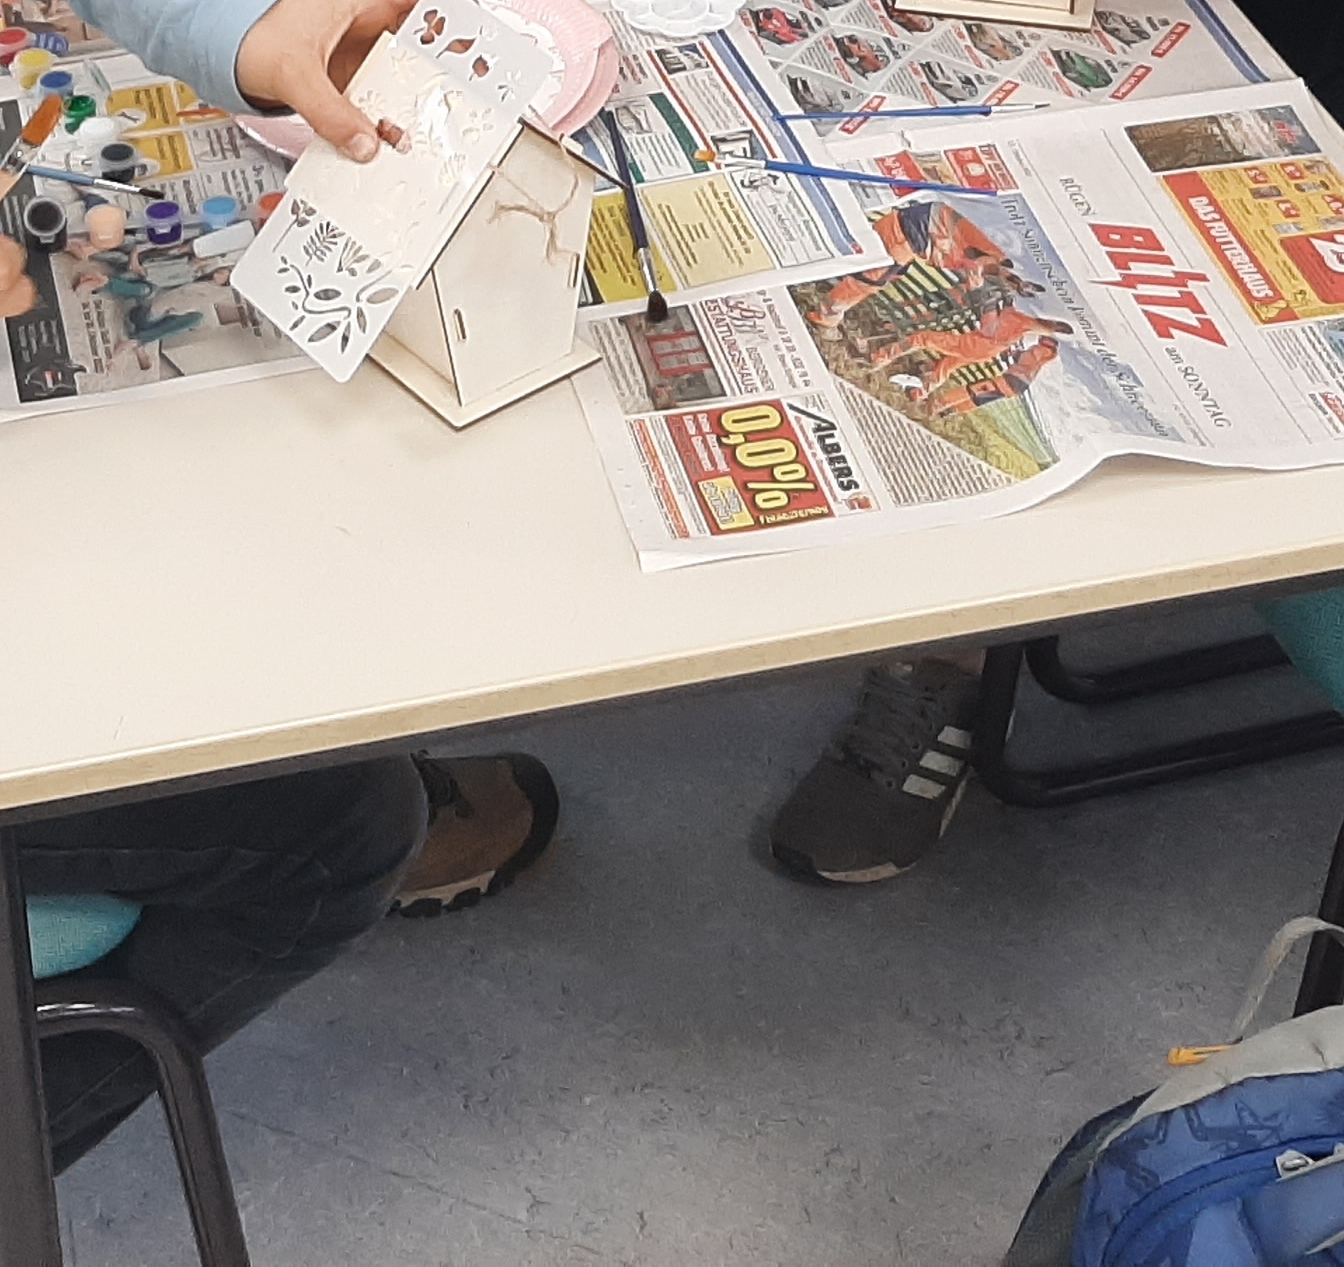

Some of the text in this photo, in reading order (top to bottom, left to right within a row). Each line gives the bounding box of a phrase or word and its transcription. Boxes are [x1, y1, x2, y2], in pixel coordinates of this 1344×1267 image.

[1187, 194, 1219, 224] DAS
[1057, 172, 1231, 428] RÜGEN BLITZ am SONNTAG
[719, 403, 814, 510] 0,0%
[787, 403, 859, 491] ALBERS
